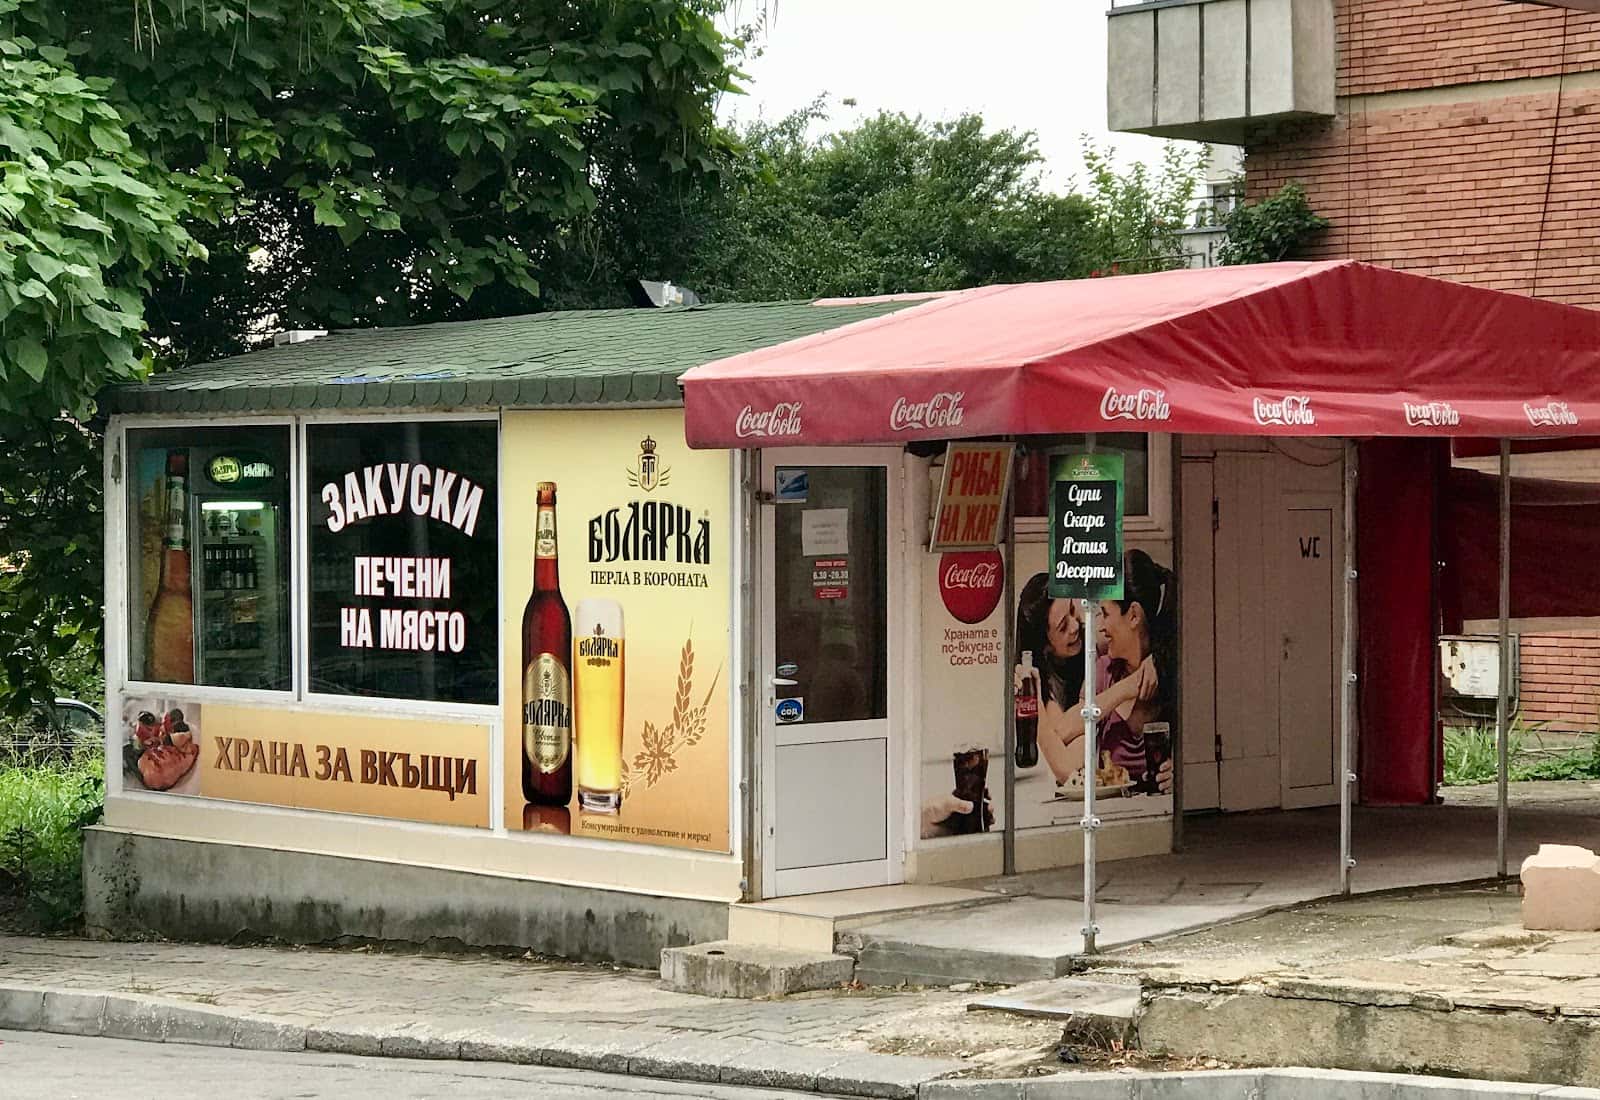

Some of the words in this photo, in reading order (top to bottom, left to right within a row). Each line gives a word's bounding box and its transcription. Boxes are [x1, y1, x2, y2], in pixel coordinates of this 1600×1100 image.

[736, 401, 803, 437] Coca-Cola
[890, 391, 965, 431] Coca-Cola
[1100, 387, 1170, 420] Coca-Cola
[1253, 396, 1315, 425] Coca-Cola
[948, 451, 1000, 496] РИБА
[321, 463, 484, 537] ЗАКУСКИ
[1068, 484, 1102, 506] Супи
[588, 501, 711, 564] БОЛЯРКА
[936, 504, 960, 542] НА
[961, 504, 999, 542] ЖАР
[1063, 510, 1105, 532] Скара
[1062, 536, 1108, 555] Ястия
[1299, 536, 1320, 558] WC
[354, 556, 450, 599] ПЕЧЕНИ
[590, 570, 630, 585] ПЕРЛА
[633, 571, 641, 586] В
[644, 572, 709, 588] КОРОНАТА
[944, 563, 998, 589] Coca-Cola
[1055, 560, 1115, 586] Десерти
[341, 607, 373, 648] НА
[380, 609, 465, 653] МЯСТО
[944, 628, 989, 642] Храната
[991, 629, 998, 638] е
[950, 652, 998, 666] Coca-Cola
[213, 735, 310, 778] ХРАНА
[315, 744, 353, 783] ЗА
[360, 749, 477, 801] ВКЪЩИ
